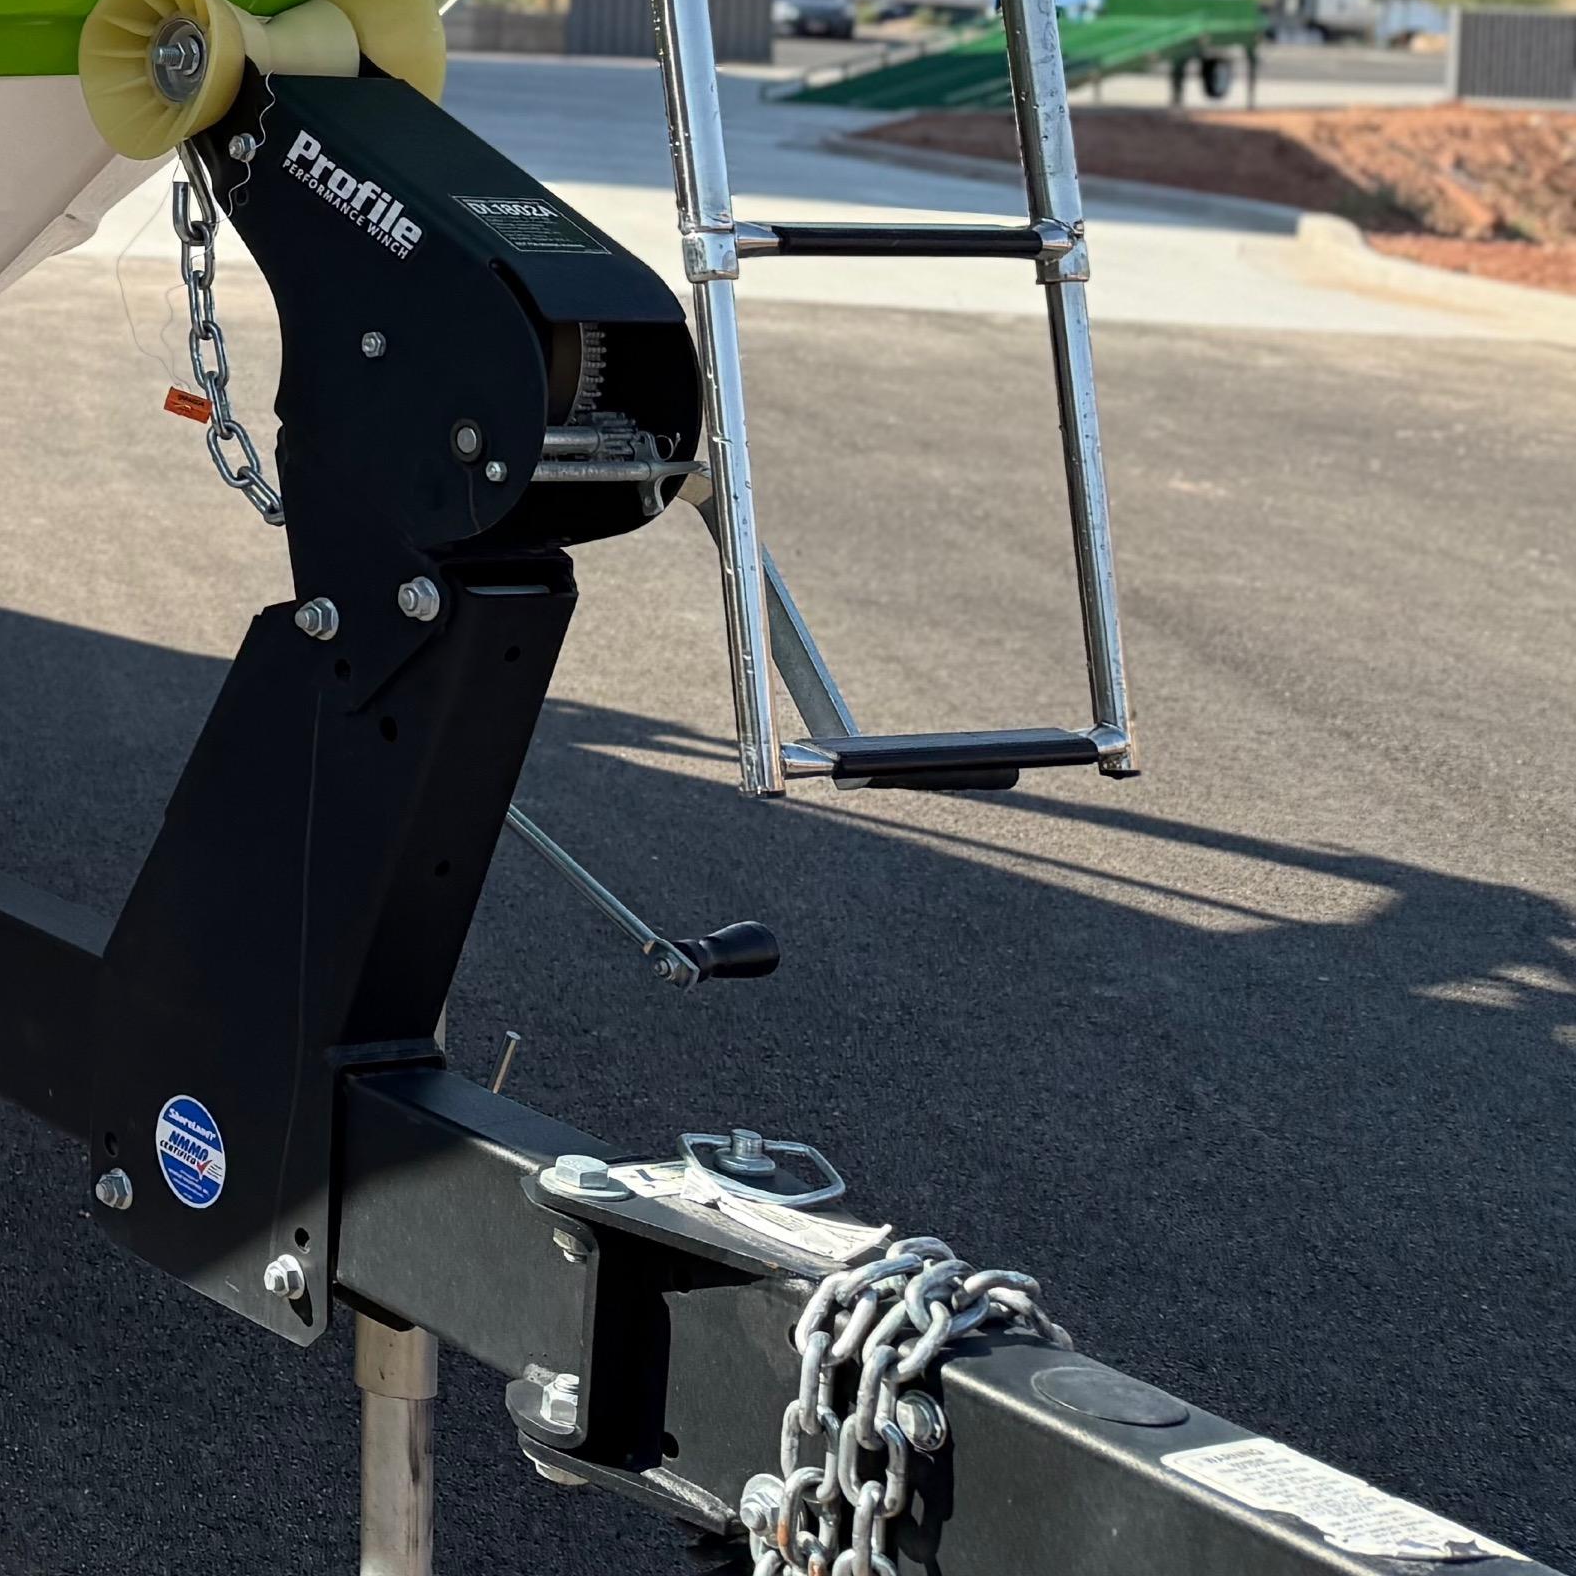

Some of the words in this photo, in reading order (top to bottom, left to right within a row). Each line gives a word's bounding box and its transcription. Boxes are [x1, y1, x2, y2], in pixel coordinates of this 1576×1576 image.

[282, 158, 366, 227] PERFORMANCE
[366, 222, 409, 260] WINCH
[286, 129, 423, 251] Profile
[159, 1139, 197, 1165] CERTIFIED
